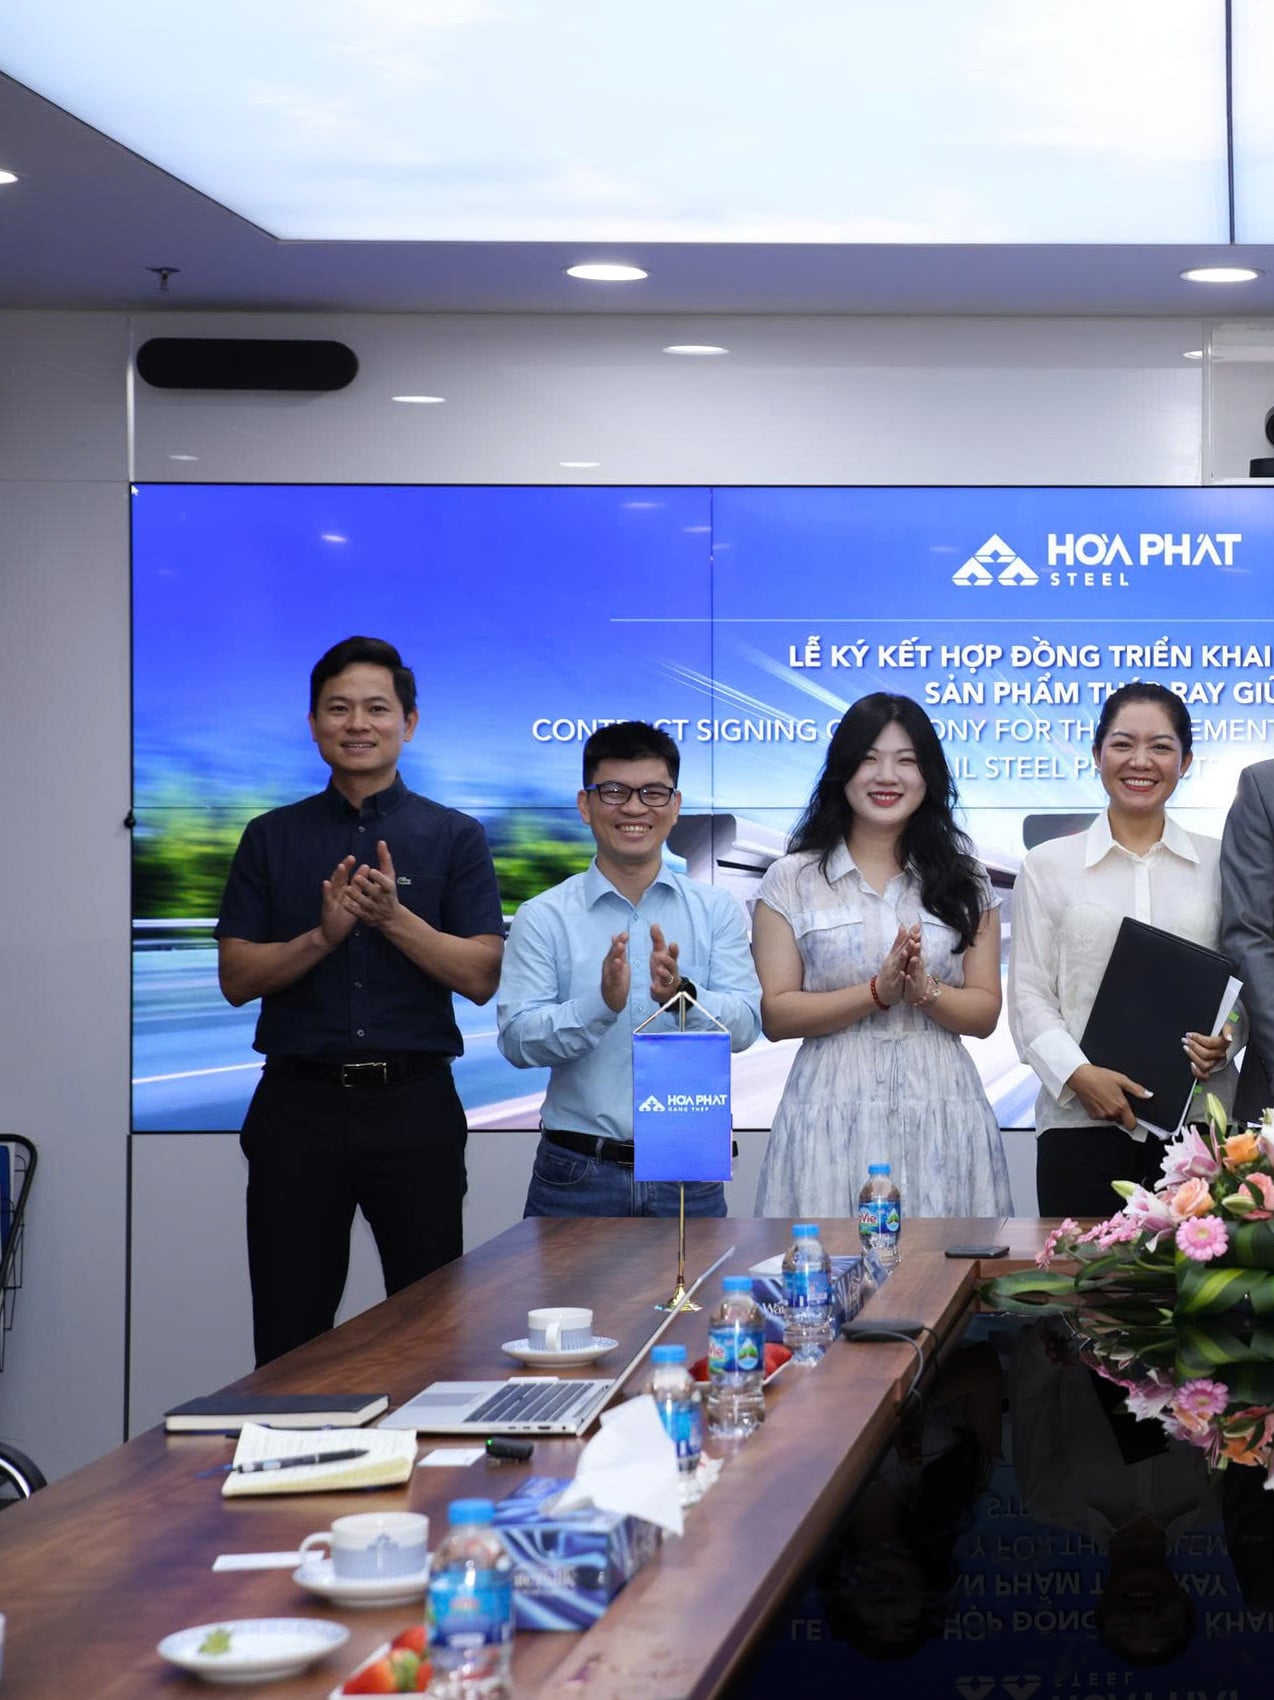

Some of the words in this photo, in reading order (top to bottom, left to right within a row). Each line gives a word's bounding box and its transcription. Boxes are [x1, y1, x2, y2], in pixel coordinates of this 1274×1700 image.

[1139, 533, 1242, 566] PHÁT
[1050, 572, 1129, 586] STEEL
[789, 635, 822, 668] LỄ
[831, 638, 870, 668] KÝ
[878, 636, 933, 668] KẾT
[941, 643, 1003, 674] HỢP
[1011, 636, 1100, 668] ĐỒNG
[1108, 636, 1193, 668] TRIỂN
[1202, 645, 1271, 668] KHAI
[924, 674, 985, 705] SẢN
[994, 672, 1080, 705] PHẨM
[1171, 681, 1226, 705] RAY
[696, 718, 818, 743] SIGNING
[995, 719, 1051, 743] FOR
[1058, 719, 1101, 742] TH
[984, 756, 1066, 779] STEEL
